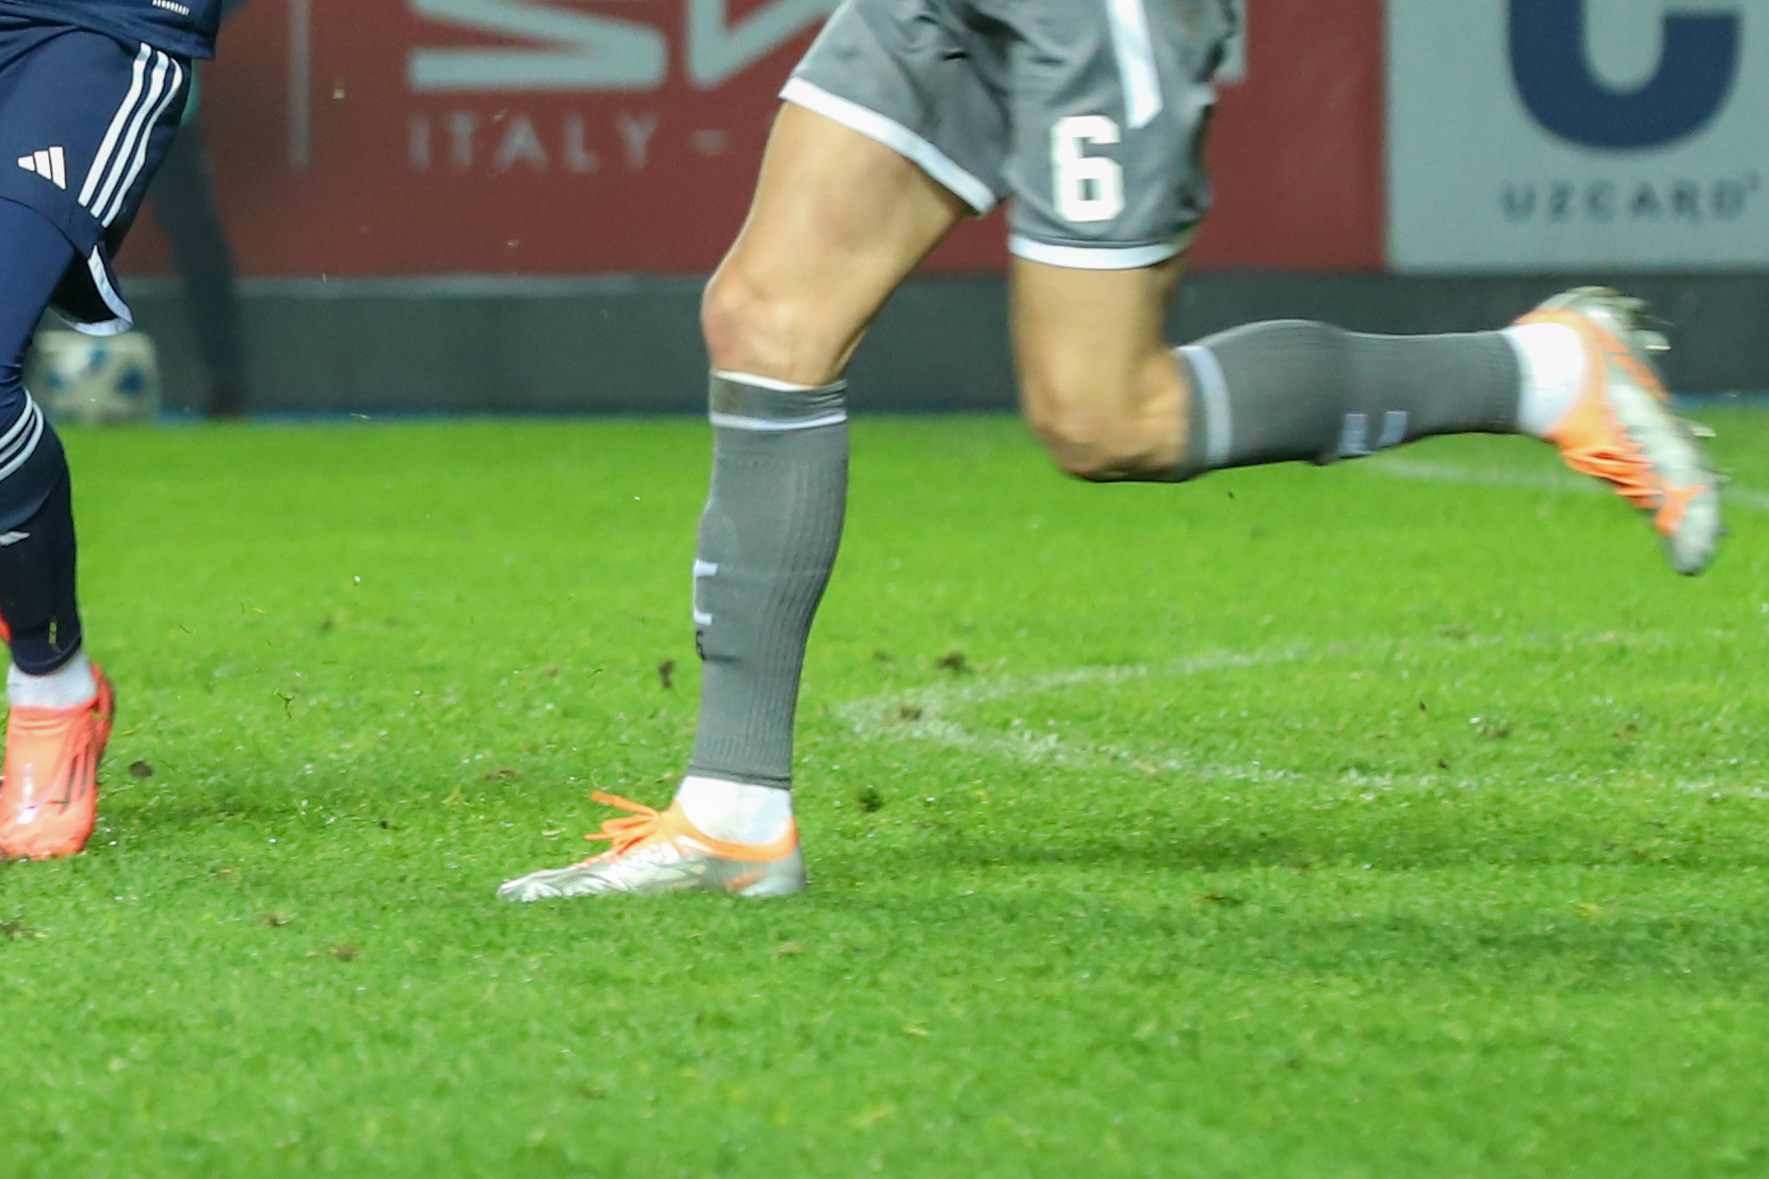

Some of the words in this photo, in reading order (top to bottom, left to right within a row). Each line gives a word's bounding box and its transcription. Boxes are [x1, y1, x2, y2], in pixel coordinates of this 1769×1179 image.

[408, 111, 660, 171] ITALY
[1052, 115, 1124, 221] 6
[1502, 178, 1748, 223] UZCARD
